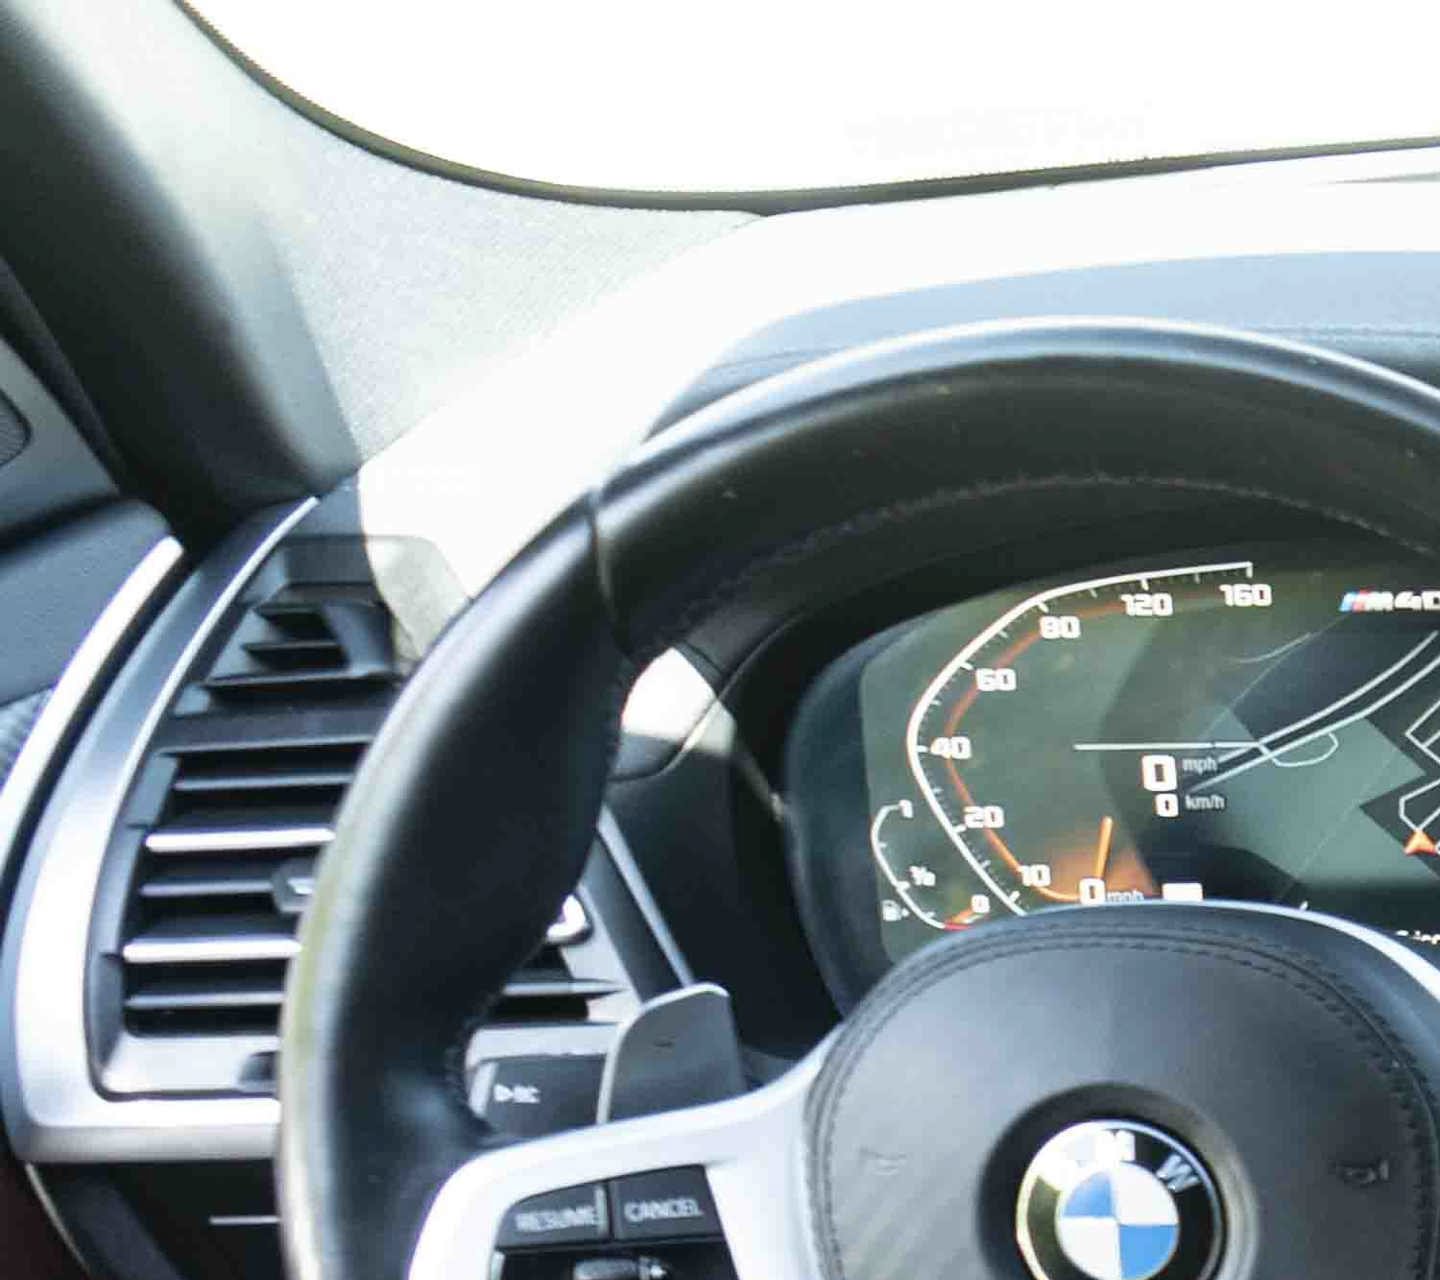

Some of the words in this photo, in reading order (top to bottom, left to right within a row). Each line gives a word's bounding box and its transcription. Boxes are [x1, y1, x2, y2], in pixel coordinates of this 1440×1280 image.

[1121, 593, 1173, 616] 120
[1219, 584, 1272, 607] 160
[1039, 616, 1081, 639] 80
[976, 668, 1016, 691] 60
[931, 736, 972, 760] 40
[1141, 755, 1178, 791] 0
[1183, 757, 1218, 773] mph
[1155, 793, 1179, 817] 0
[1186, 795, 1225, 810] km/h
[963, 806, 1004, 828] 20
[1017, 864, 1051, 886] 10
[1080, 877, 1106, 905] 0
